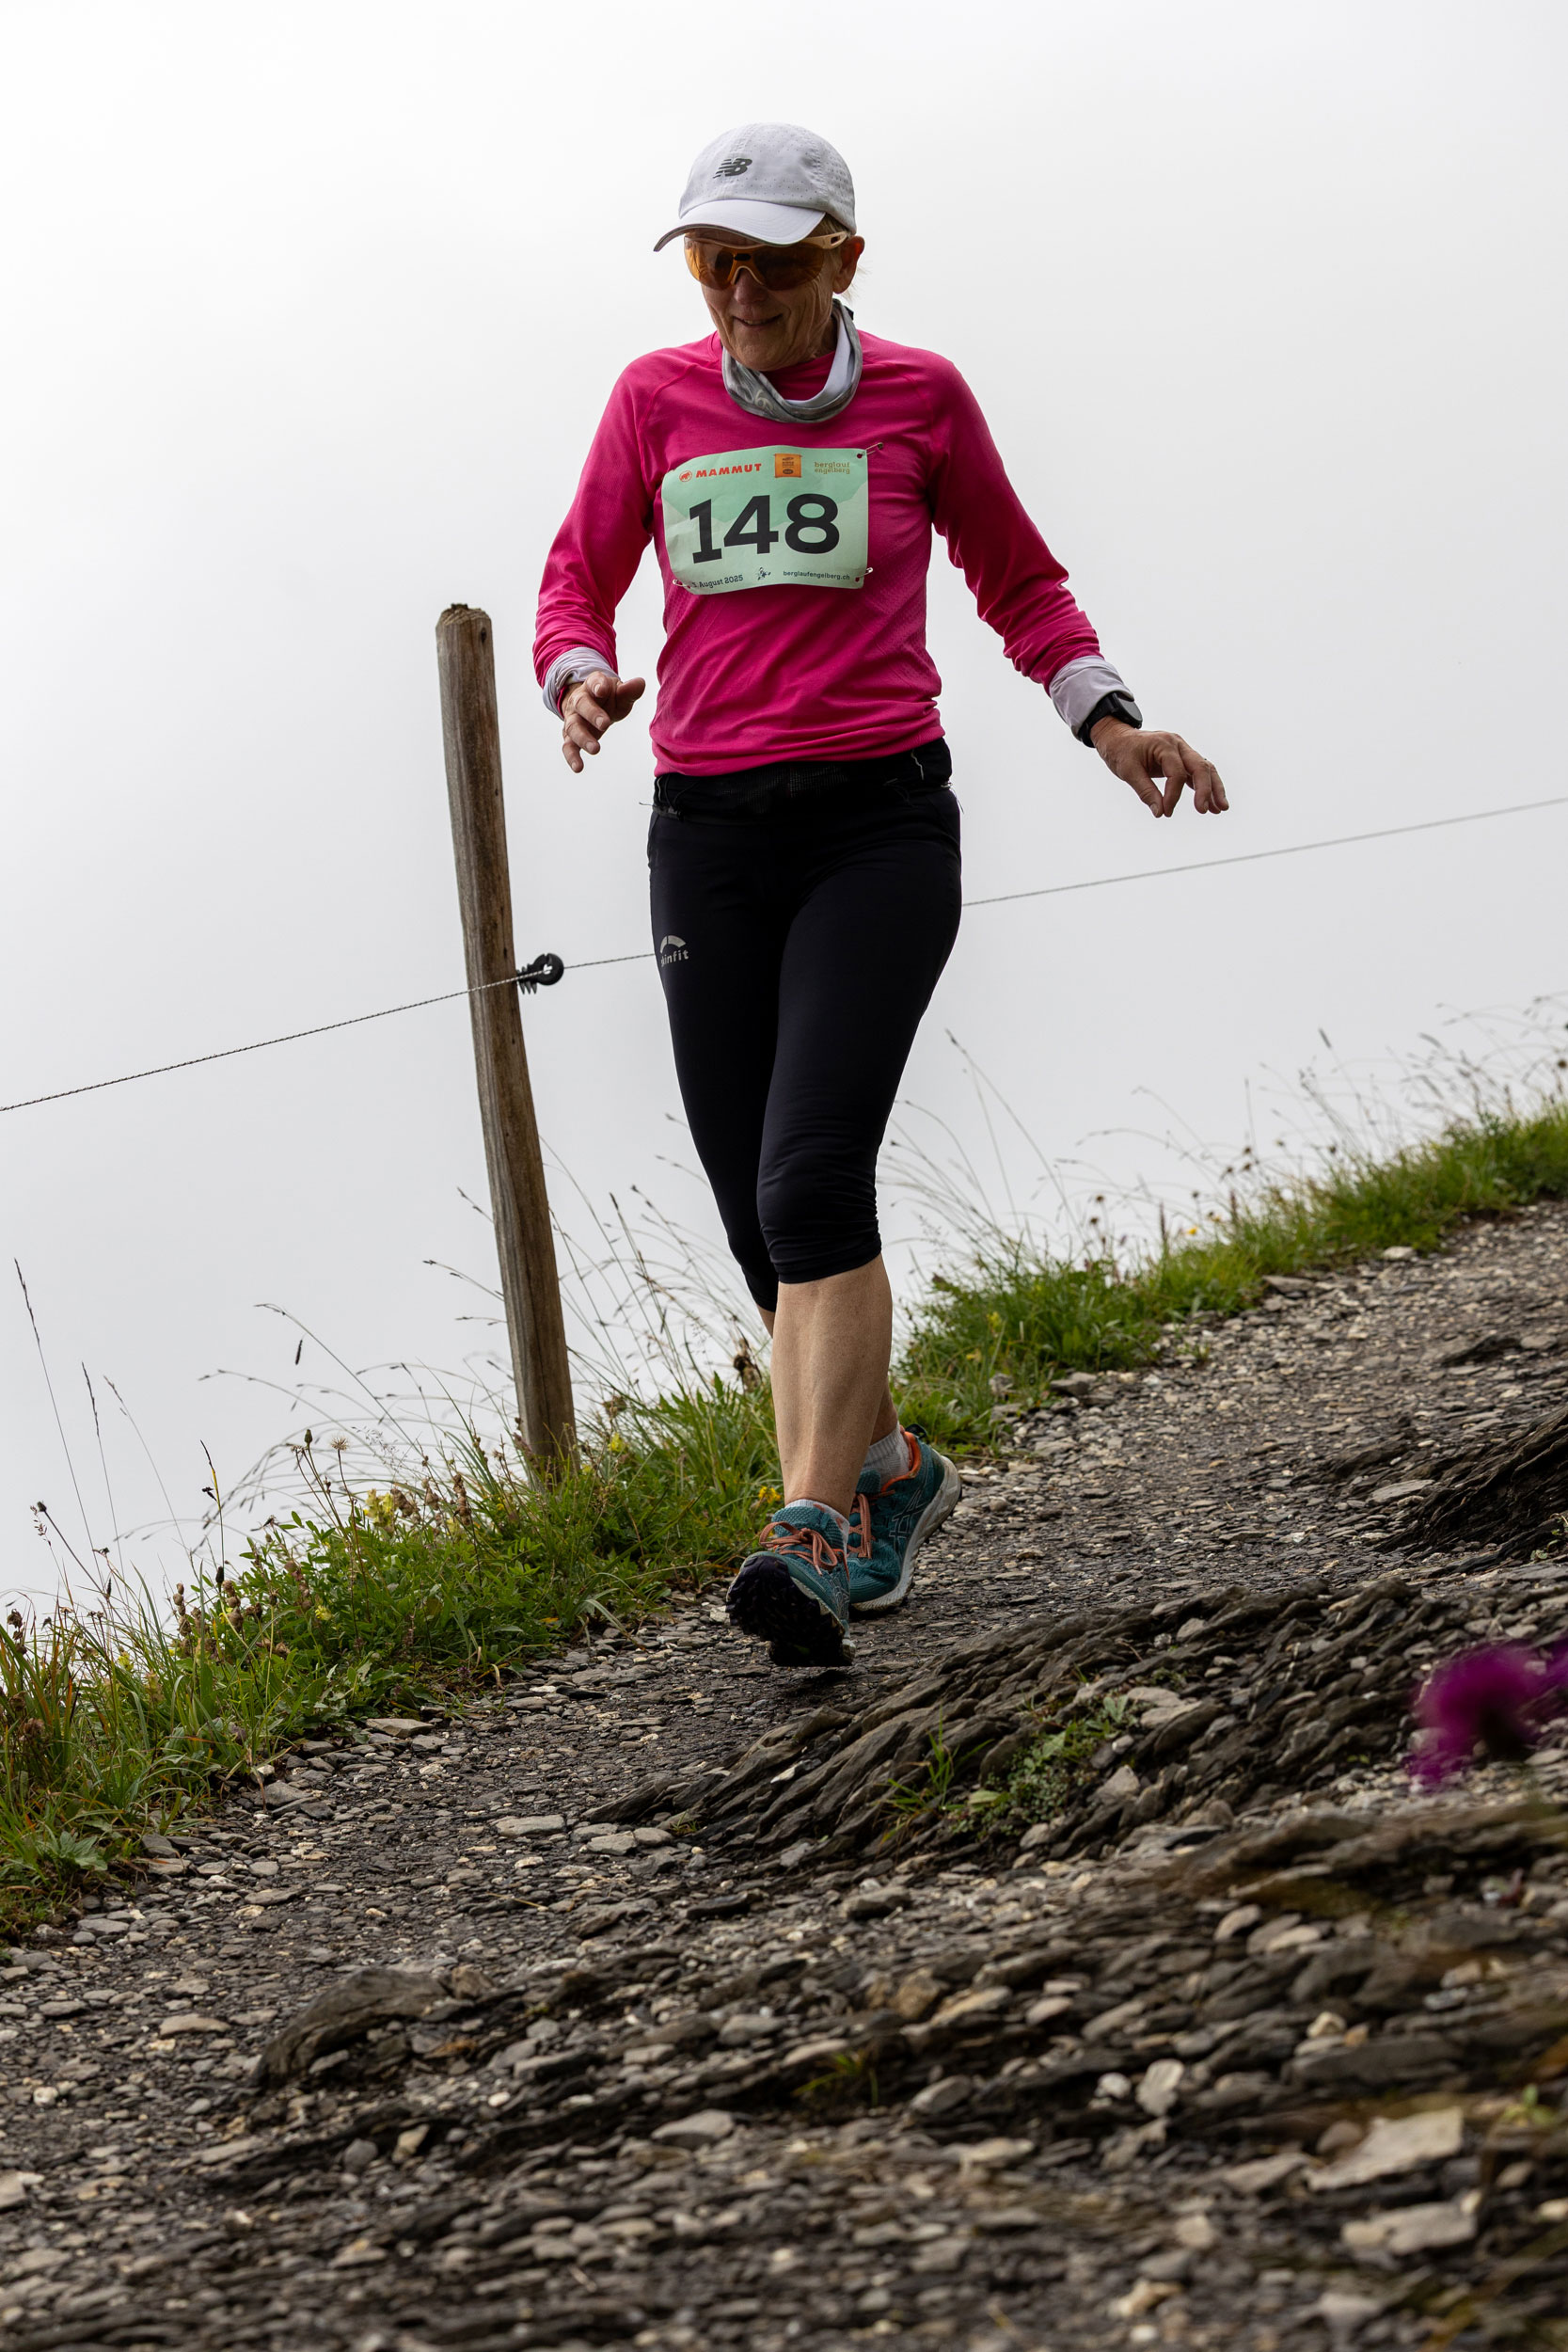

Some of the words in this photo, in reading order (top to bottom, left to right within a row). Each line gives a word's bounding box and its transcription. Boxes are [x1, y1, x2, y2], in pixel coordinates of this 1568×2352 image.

[695, 463, 762, 478] MAMMUT
[689, 493, 839, 564] 148
[699, 579, 723, 589] August
[723, 574, 744, 584] 2025
[783, 570, 850, 580] berglaufengelberg.ch
